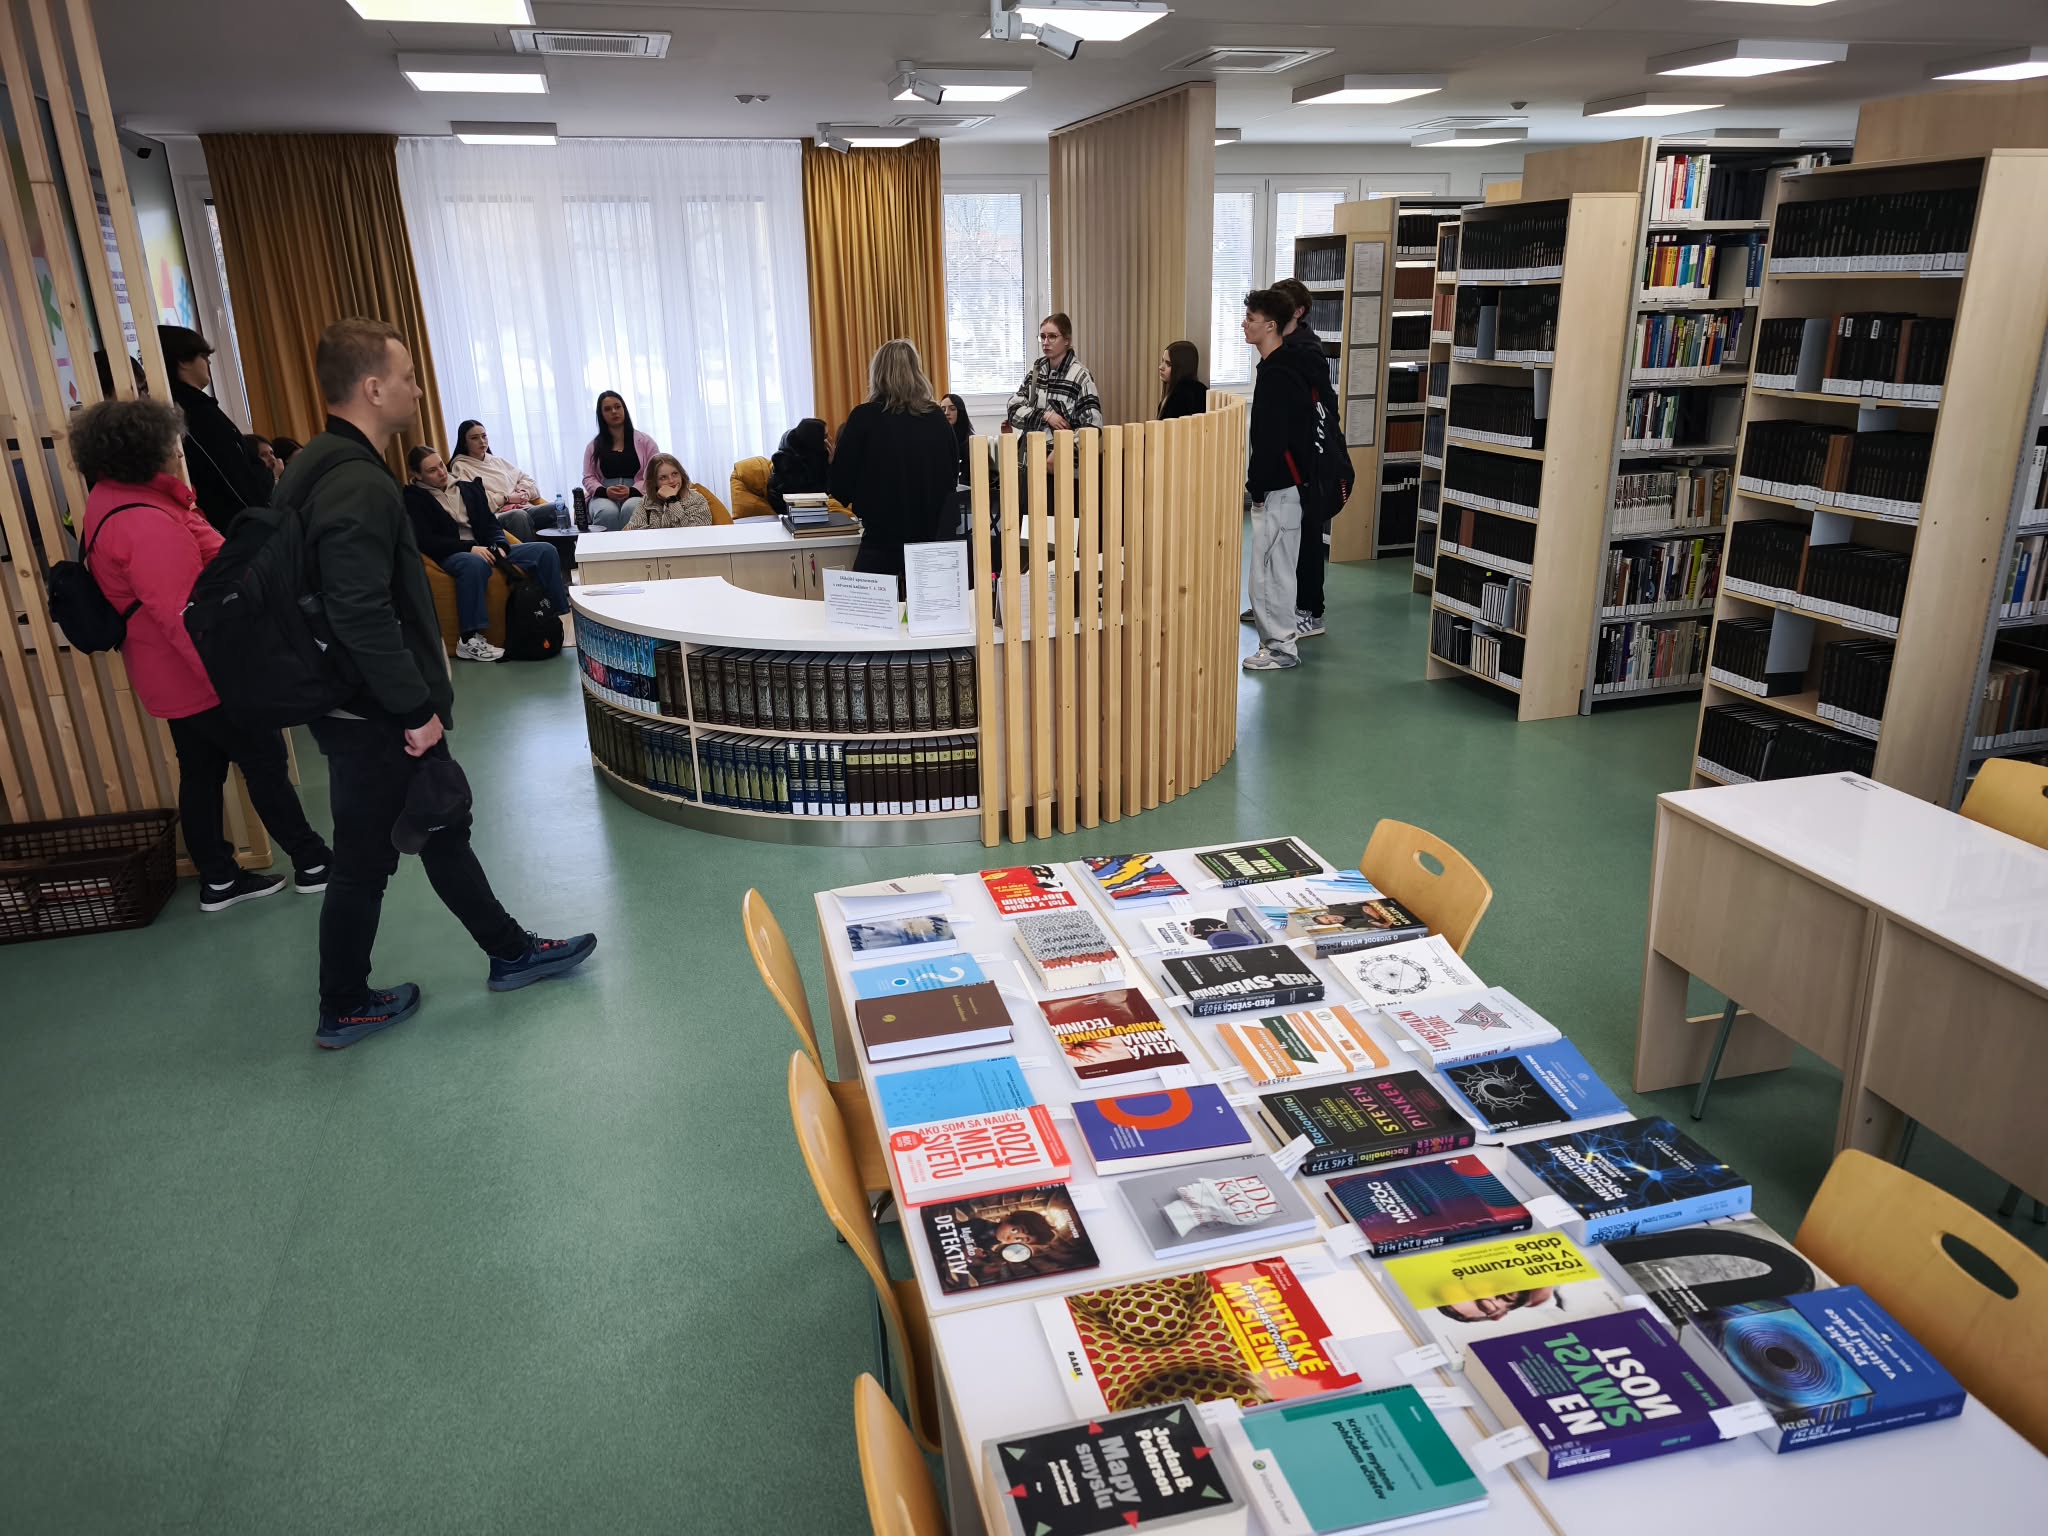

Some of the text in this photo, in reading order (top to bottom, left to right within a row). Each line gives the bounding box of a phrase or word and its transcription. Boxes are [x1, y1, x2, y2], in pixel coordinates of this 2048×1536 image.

[1121, 1027, 1178, 1047] KNIHA
[1125, 1038, 1182, 1060] VELKÁ
[918, 1112, 1022, 1138] AKO SOM SA NAUČIL
[1282, 1096, 1328, 1147] Racionalita
[1351, 1085, 1400, 1133] STEVEN
[1375, 1080, 1430, 1131] PINKER
[922, 1133, 963, 1180] SVETU
[952, 1127, 1003, 1171] MIEŤ
[991, 1121, 1041, 1167] ROZU
[1235, 1175, 1282, 1215] EDU
[1549, 1146, 1616, 1202] MEZIKULTURNÍ
[1561, 1144, 1628, 1199] PSYCHOLOGIE
[1215, 1180, 1257, 1222] KACE
[1368, 1181, 1410, 1225] MOZOG
[934, 1214, 970, 1276] DETEKTÍV
[1452, 1251, 1556, 1280] nerozumné
[1514, 1236, 1562, 1252] době
[1526, 1257, 1584, 1277] rozum
[1240, 1284, 1260, 1304] pre
[1218, 1281, 1294, 1381] MYSLENIE
[1247, 1274, 1330, 1376] KRITICKÉ
[1824, 1323, 1871, 1366] Projekt
[1075, 1442, 1114, 1510] smyslu
[1098, 1434, 1142, 1503] Mapy
[1134, 1428, 1174, 1497] Peterson
[1152, 1426, 1195, 1494] Jordan B.
[1332, 1420, 1387, 1501] pohľadom učiteľov
[1346, 1418, 1372, 1452] Kritické
[1366, 1451, 1396, 1492] myslenie
